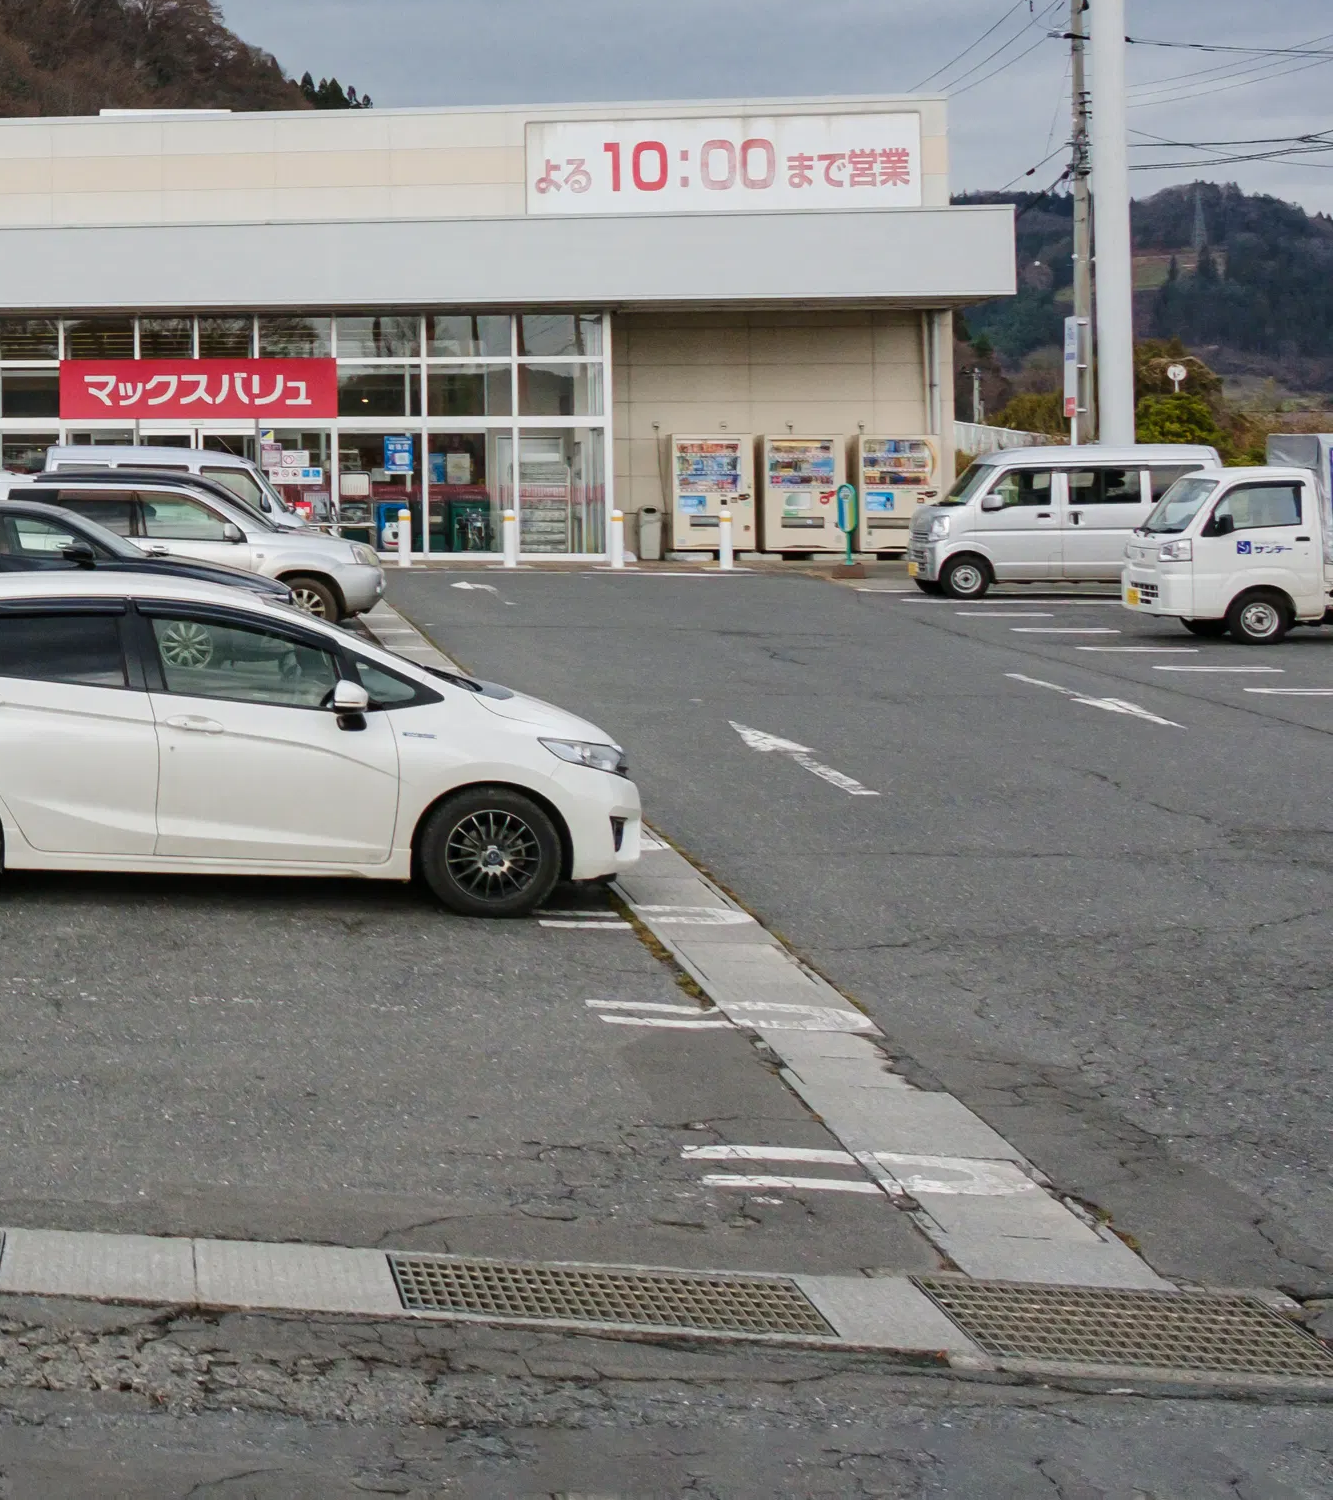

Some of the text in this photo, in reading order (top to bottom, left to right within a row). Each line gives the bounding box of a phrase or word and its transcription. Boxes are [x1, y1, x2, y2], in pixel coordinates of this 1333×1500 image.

[83, 372, 312, 406] マックスバリュ
[1254, 545, 1293, 554] サンデー
